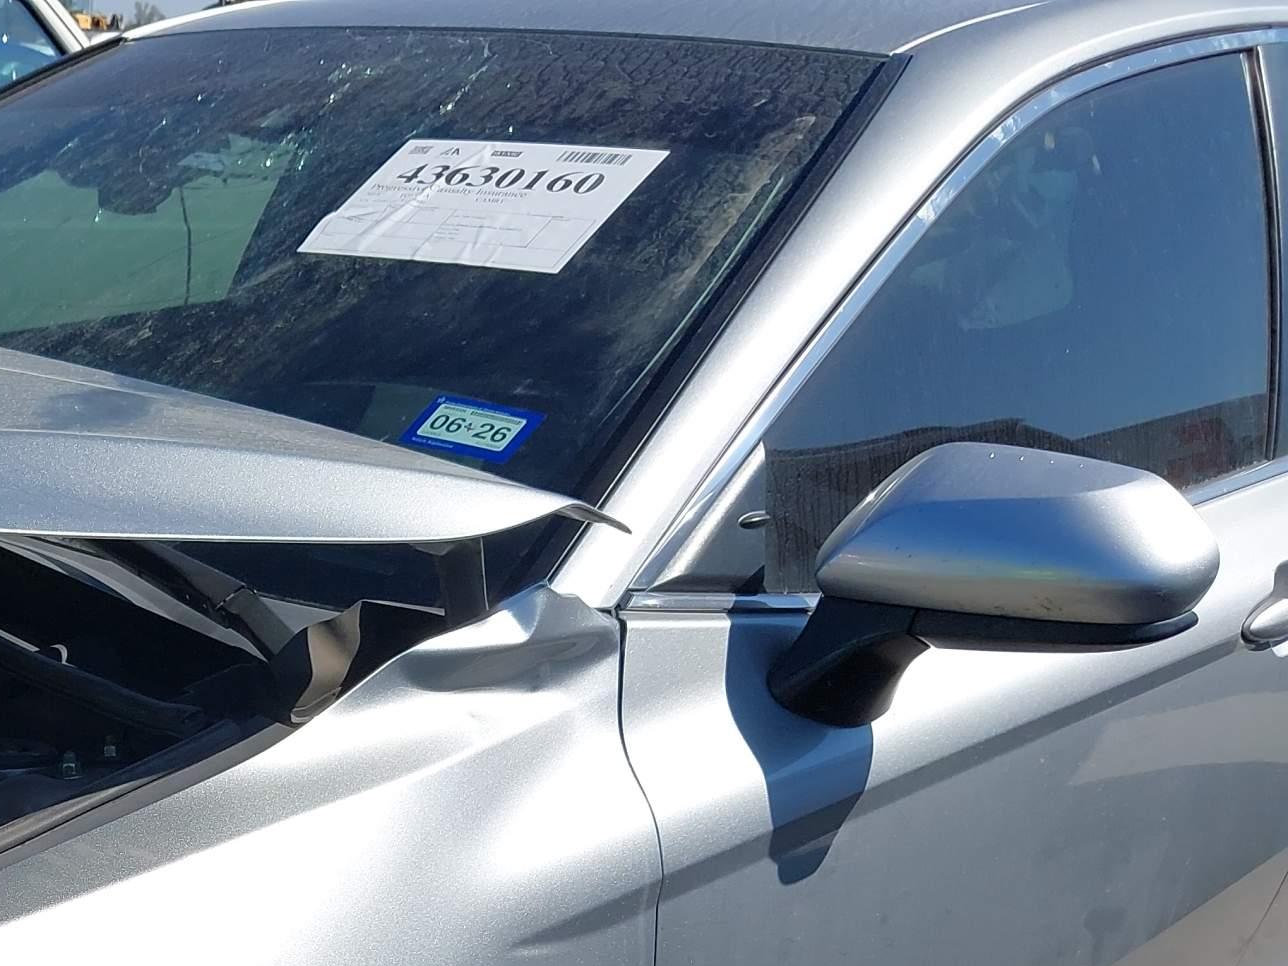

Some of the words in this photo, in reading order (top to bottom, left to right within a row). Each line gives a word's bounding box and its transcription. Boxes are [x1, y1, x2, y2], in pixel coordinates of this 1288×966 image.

[396, 163, 606, 195] 43630160
[429, 414, 466, 434] 06
[471, 422, 512, 443] 26
